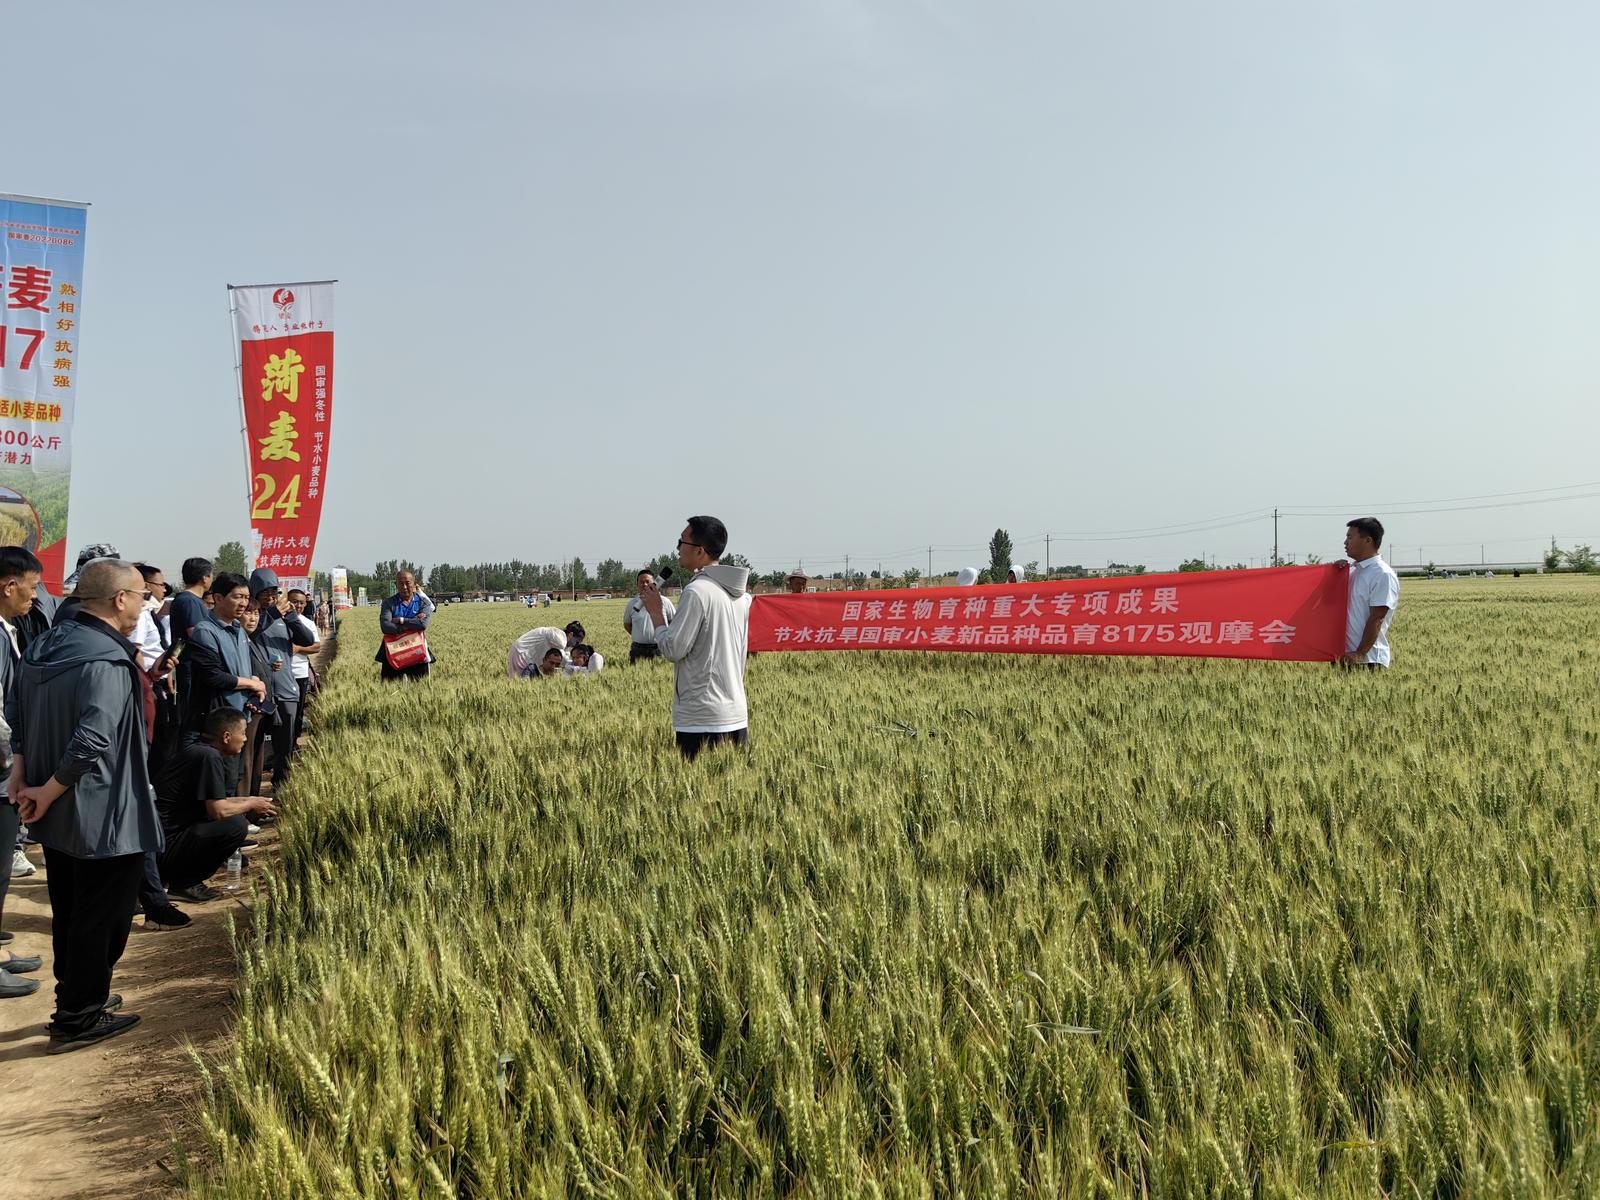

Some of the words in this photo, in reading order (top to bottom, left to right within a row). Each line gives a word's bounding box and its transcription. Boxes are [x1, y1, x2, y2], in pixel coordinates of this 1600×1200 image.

[0, 265, 51, 313] 麦
[0, 429, 61, 450] 00公斤
[308, 432, 324, 499] 节水小麦品种
[841, 587, 1180, 621] 国家生物育种重大专项成果
[774, 619, 1297, 645] 节水抗旱国审小麦新品种品育8175观摩会
